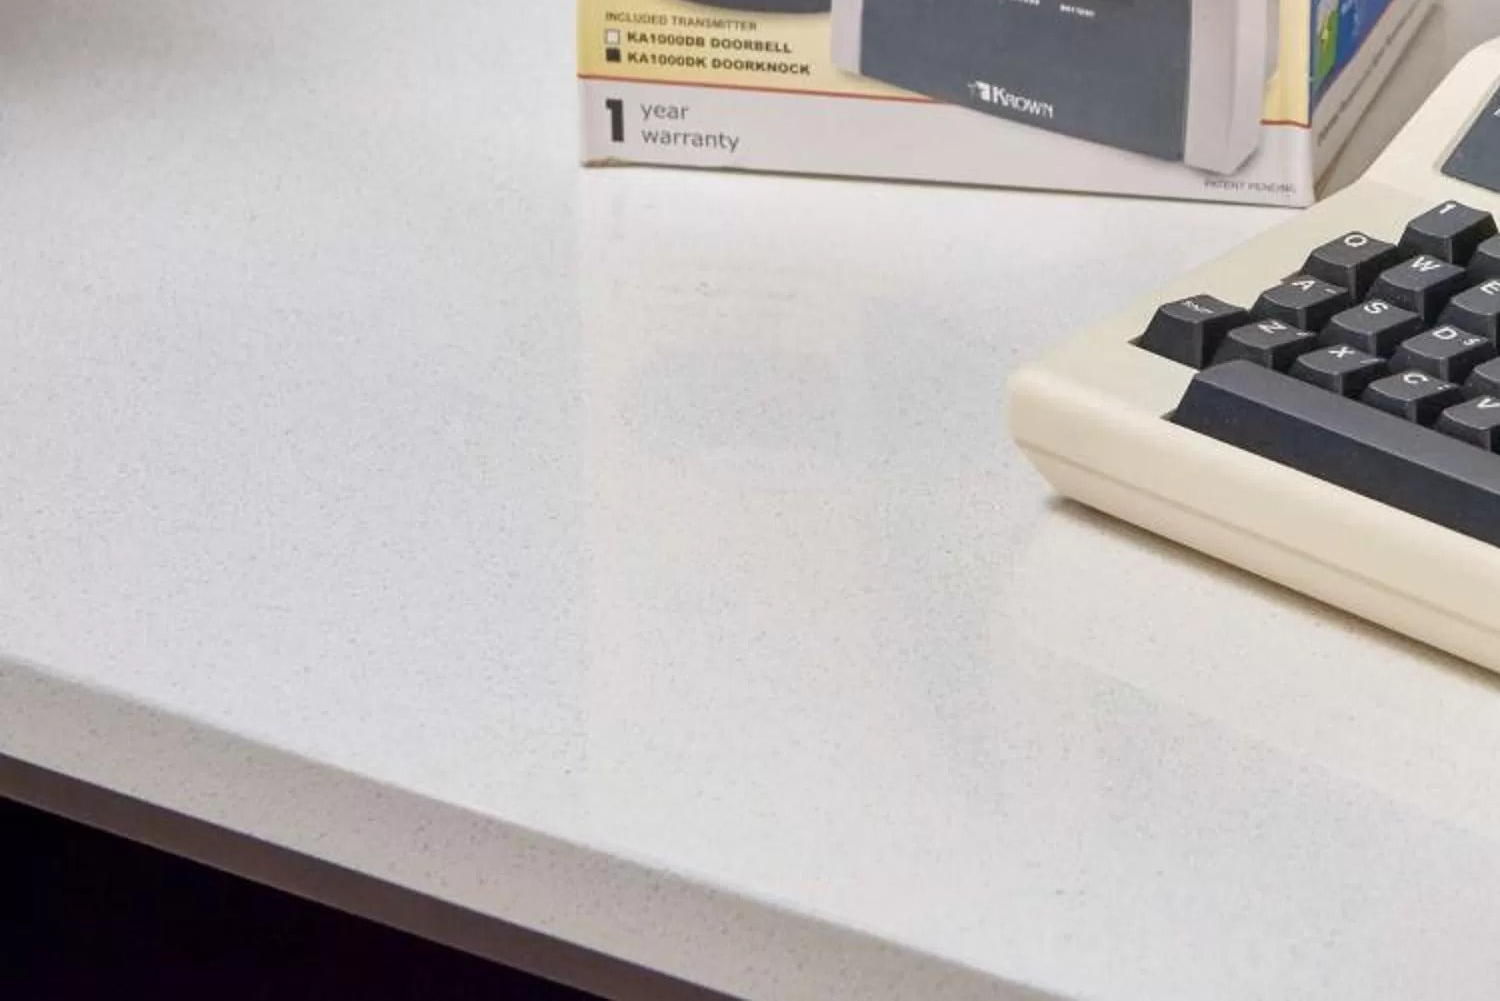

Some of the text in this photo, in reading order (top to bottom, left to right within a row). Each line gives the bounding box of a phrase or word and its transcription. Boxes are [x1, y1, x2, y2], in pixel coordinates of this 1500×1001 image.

[605, 11, 758, 32] INCLUDED TRANSMITTER
[710, 36, 793, 54] DOORBELL
[627, 51, 812, 76] KA1000DK DOORKNOCK
[605, 97, 690, 143] 1 year
[641, 127, 740, 153] warranty
[1438, 202, 1457, 216] 1
[1410, 255, 1441, 272] W
[1291, 278, 1316, 292] A
[1363, 301, 1389, 314] S
[1257, 319, 1288, 335] Z
[1432, 325, 1459, 340] D
[1327, 345, 1355, 360] X
[1403, 371, 1430, 385] C
